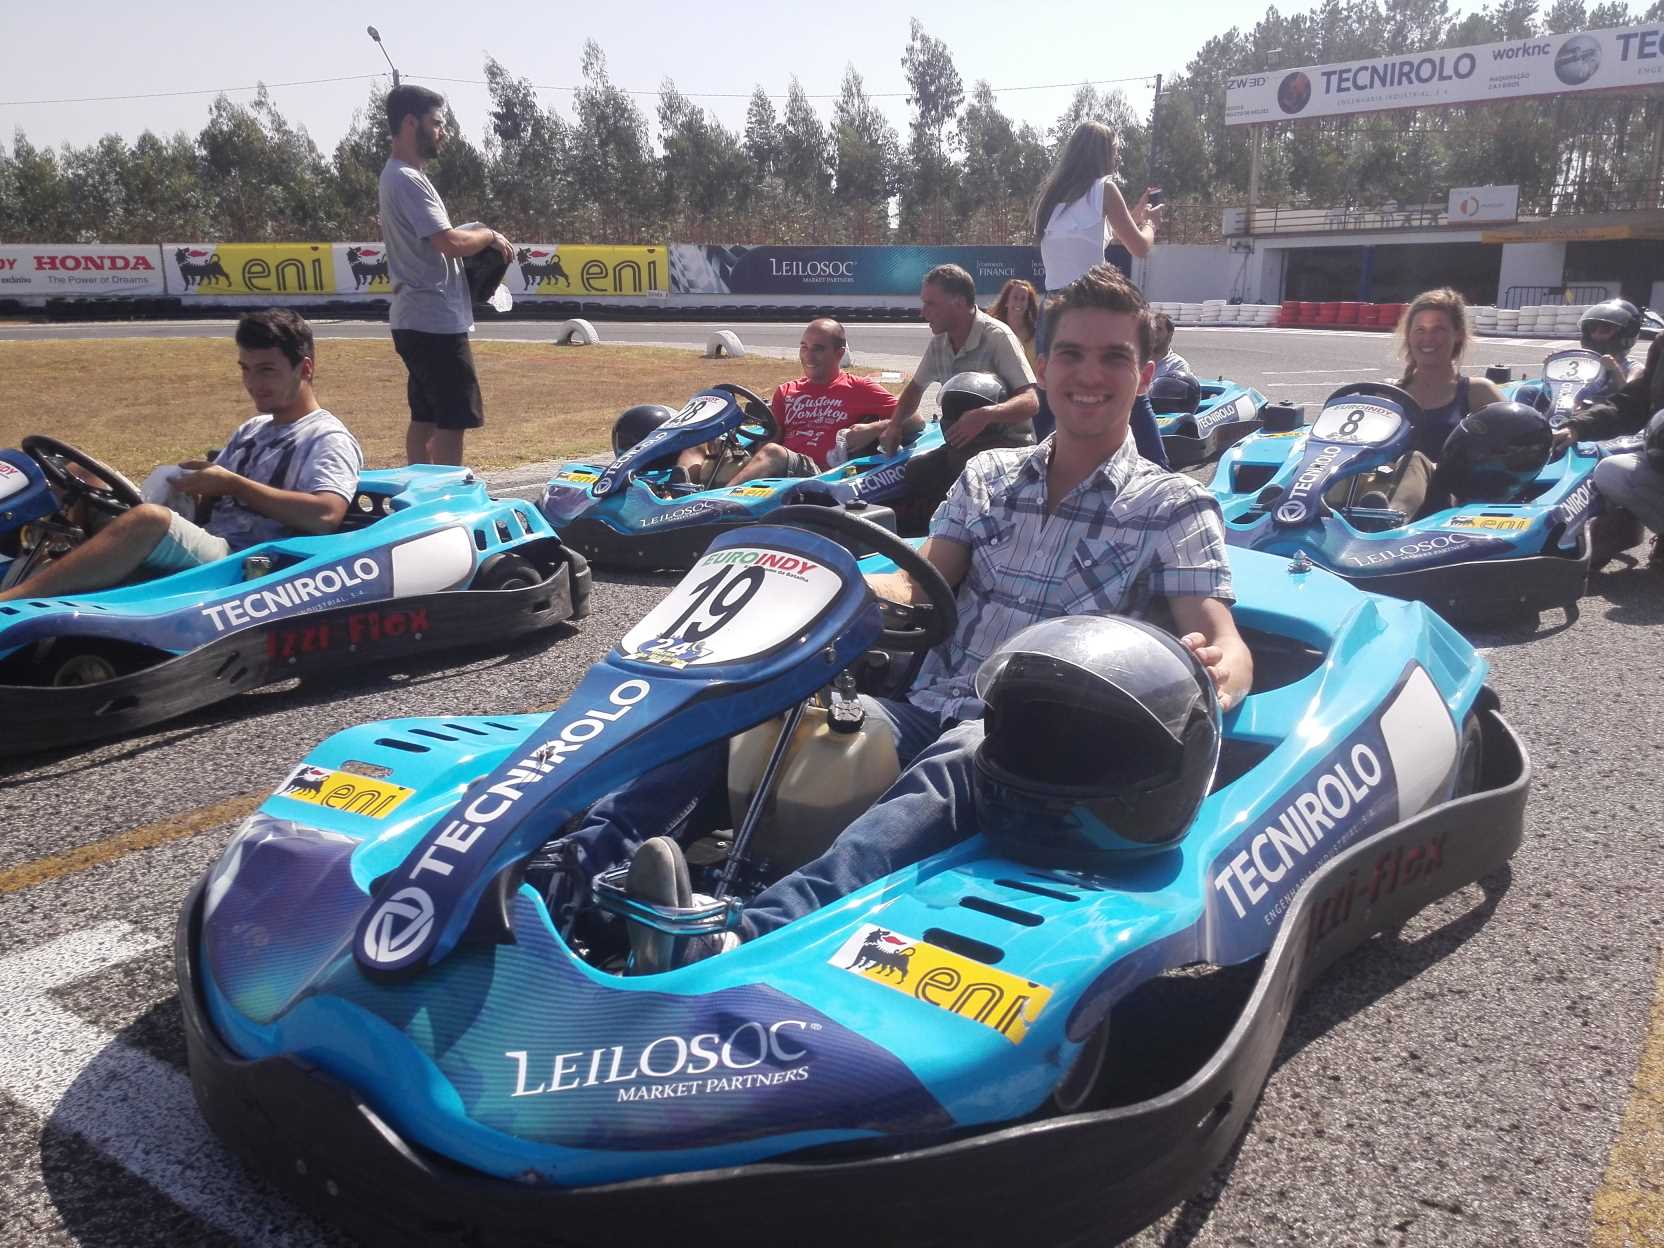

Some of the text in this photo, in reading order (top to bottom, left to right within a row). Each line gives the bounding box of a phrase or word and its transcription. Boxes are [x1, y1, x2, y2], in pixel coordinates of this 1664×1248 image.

[1492, 42, 1550, 61] worknc
[1321, 53, 1476, 94] TECNIROLO
[33, 255, 155, 271] HONDA
[68, 276, 97, 284] Power
[112, 275, 149, 284] Dreams
[242, 246, 324, 291] eni
[581, 249, 657, 292] eni
[770, 258, 855, 276] LEILOSOC
[1566, 360, 1580, 377] 3
[671, 401, 707, 423] 28
[793, 394, 843, 411] Custom
[1339, 410, 1365, 436] 8
[702, 551, 818, 575] EUROINDY
[1350, 533, 1467, 567] LEILOSOC
[202, 557, 380, 632] TECNIROLO
[660, 564, 765, 642] 19
[409, 679, 651, 880] TECNIROLO
[319, 781, 408, 817] eni
[1214, 743, 1382, 919] TECNIROLO
[914, 966, 1039, 1034] eni
[505, 1020, 808, 1097] LEILOSOC
[617, 1065, 809, 1102] MARKET PARTNERS
